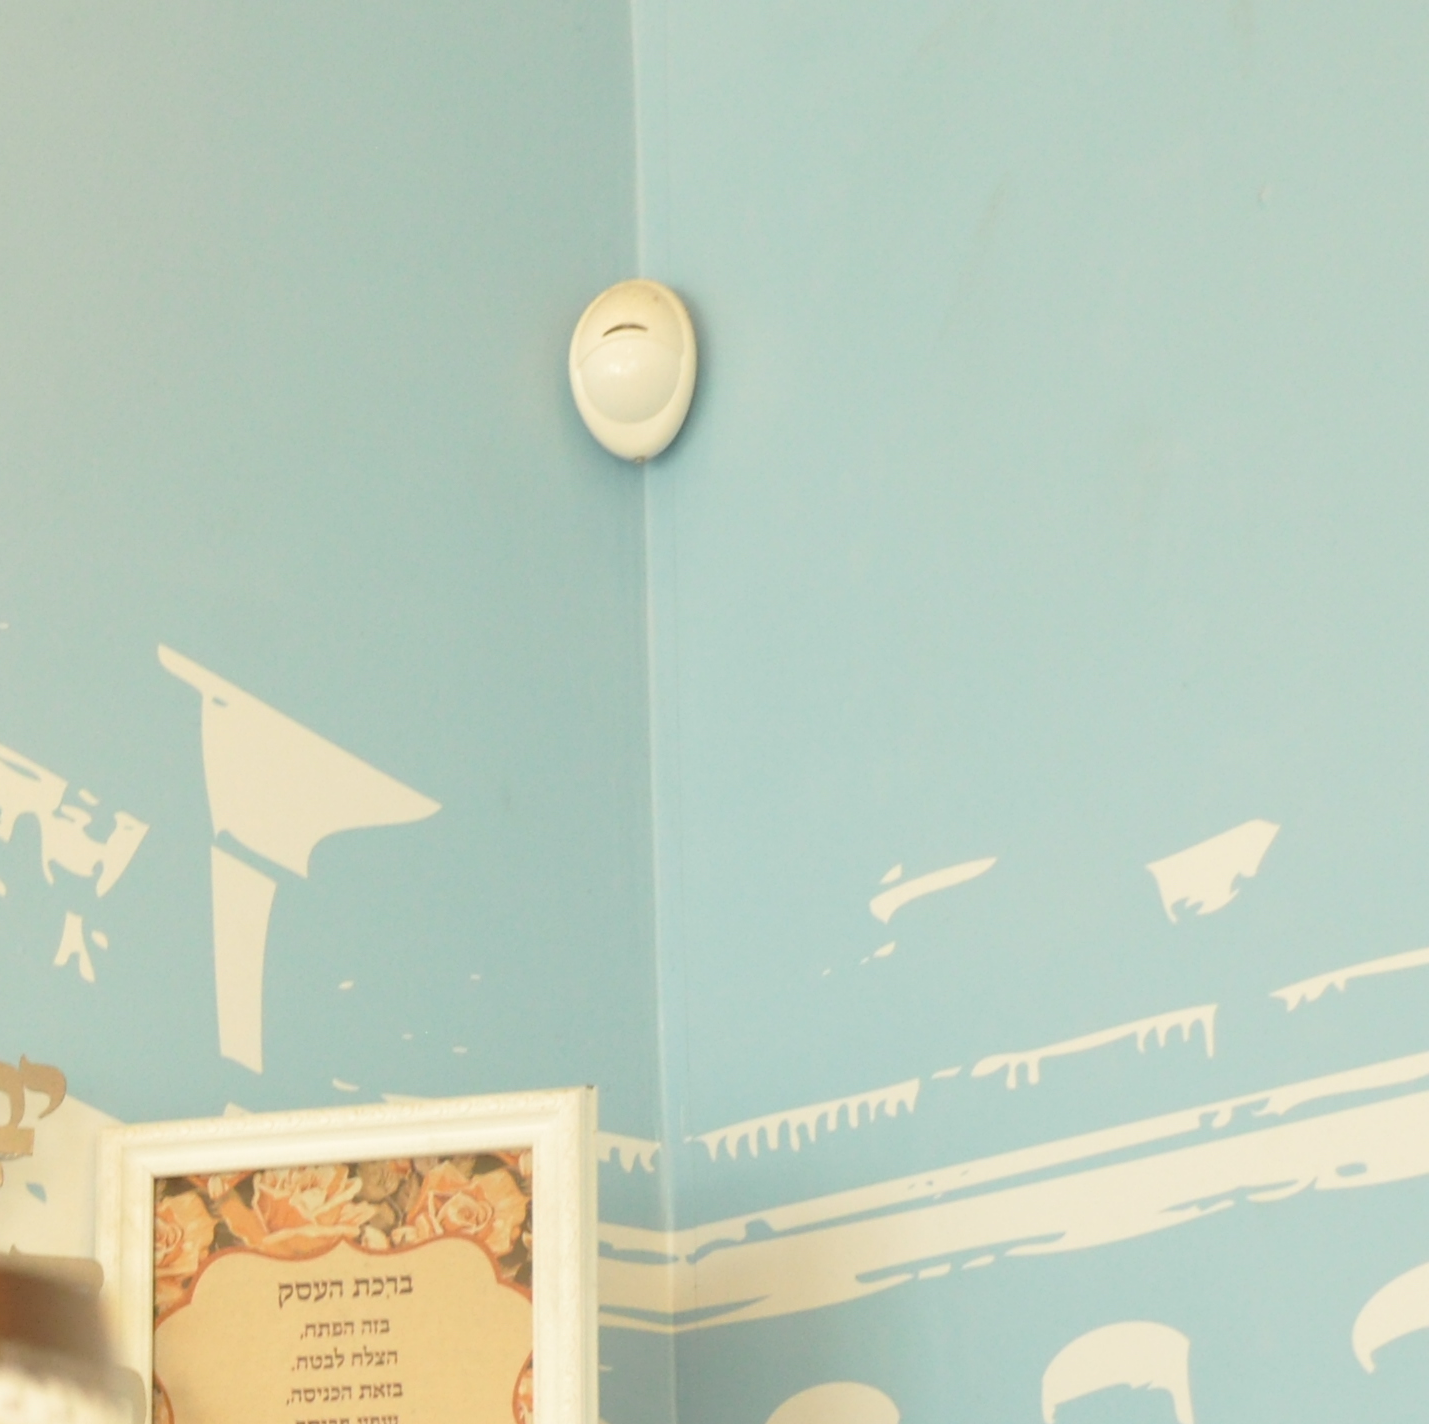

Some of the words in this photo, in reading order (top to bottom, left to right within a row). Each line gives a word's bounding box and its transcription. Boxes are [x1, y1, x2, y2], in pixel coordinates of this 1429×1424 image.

[278, 1279, 344, 1309] העסק
[352, 1274, 413, 1299] ברכת
[300, 1321, 355, 1340] הפתח,
[361, 1318, 390, 1335] בזה
[291, 1347, 345, 1371] לבטח.
[351, 1345, 398, 1367] הצלח
[286, 1386, 352, 1406] הכניסה,
[358, 1382, 403, 1400] בזאת
